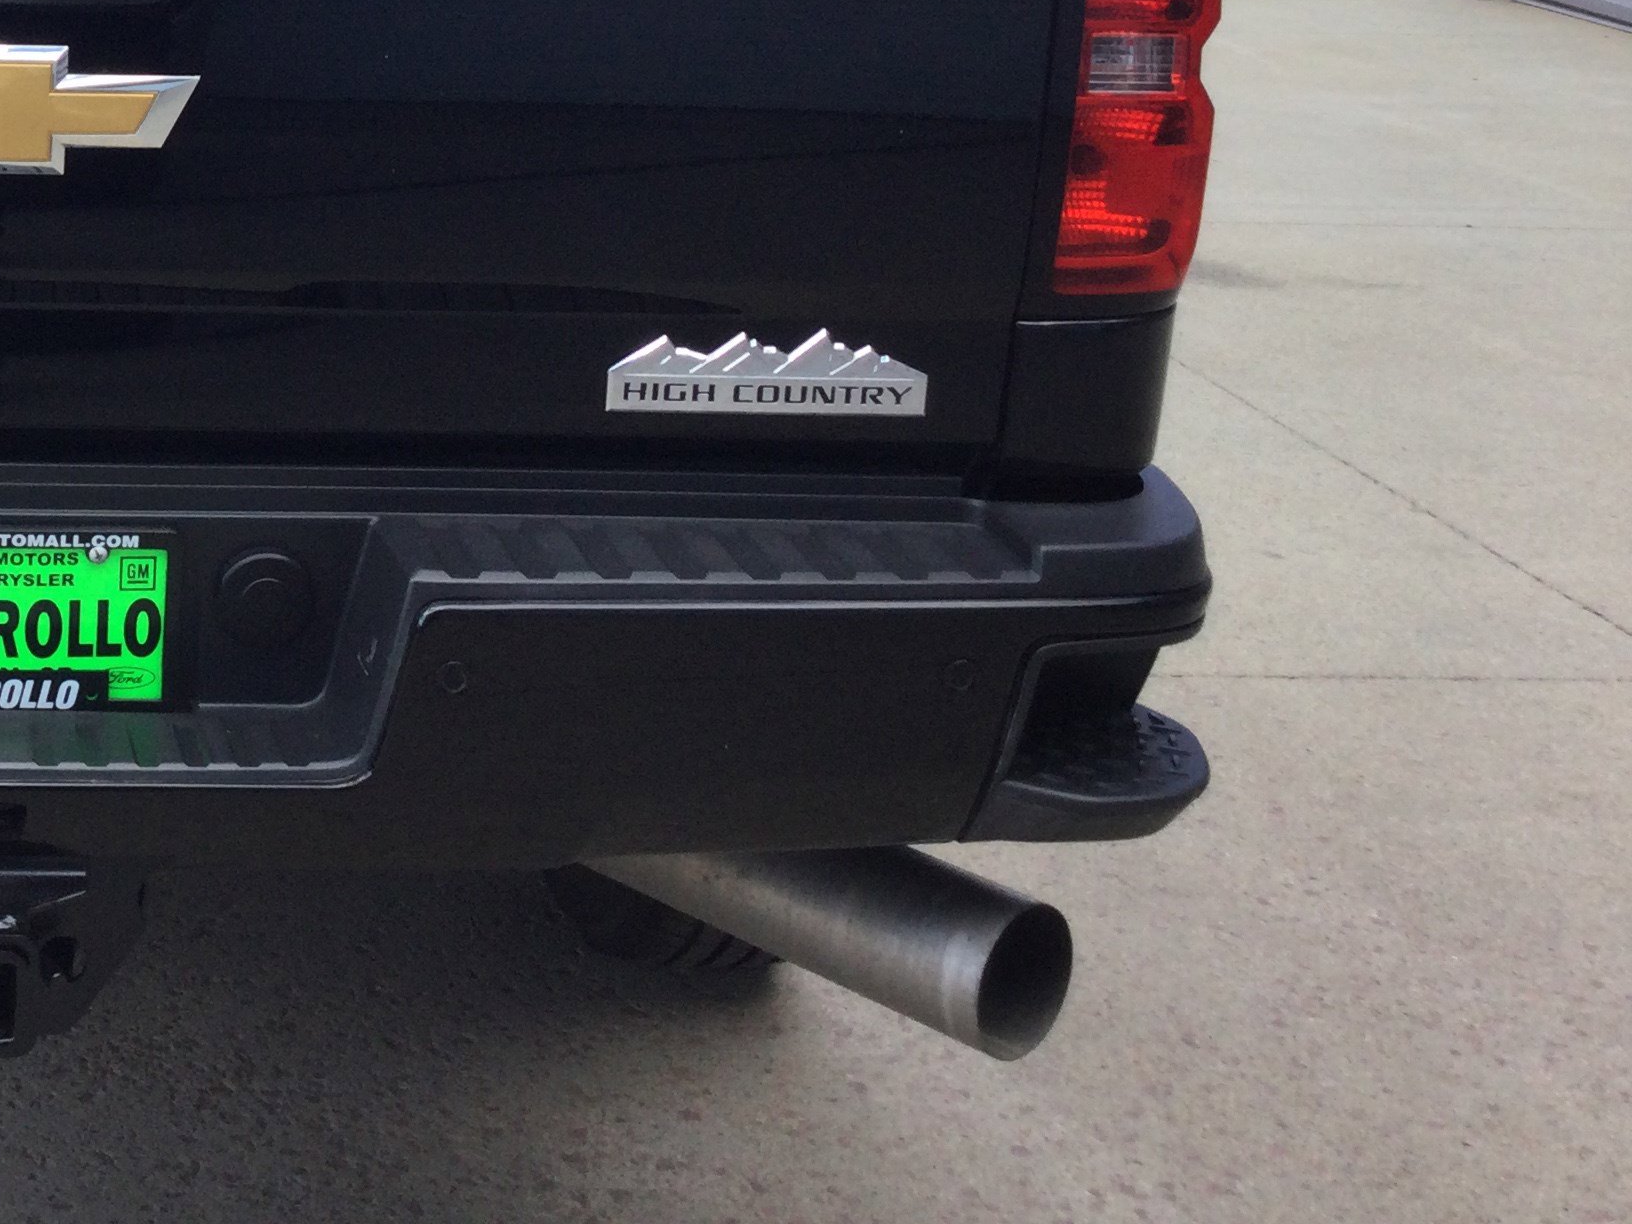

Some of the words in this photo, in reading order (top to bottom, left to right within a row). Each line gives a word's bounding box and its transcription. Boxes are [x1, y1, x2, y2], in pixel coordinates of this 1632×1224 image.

[623, 382, 716, 403] HIGH
[732, 384, 912, 406] COUNTRY
[126, 564, 150, 580] GM
[108, 670, 144, 686] Ford
